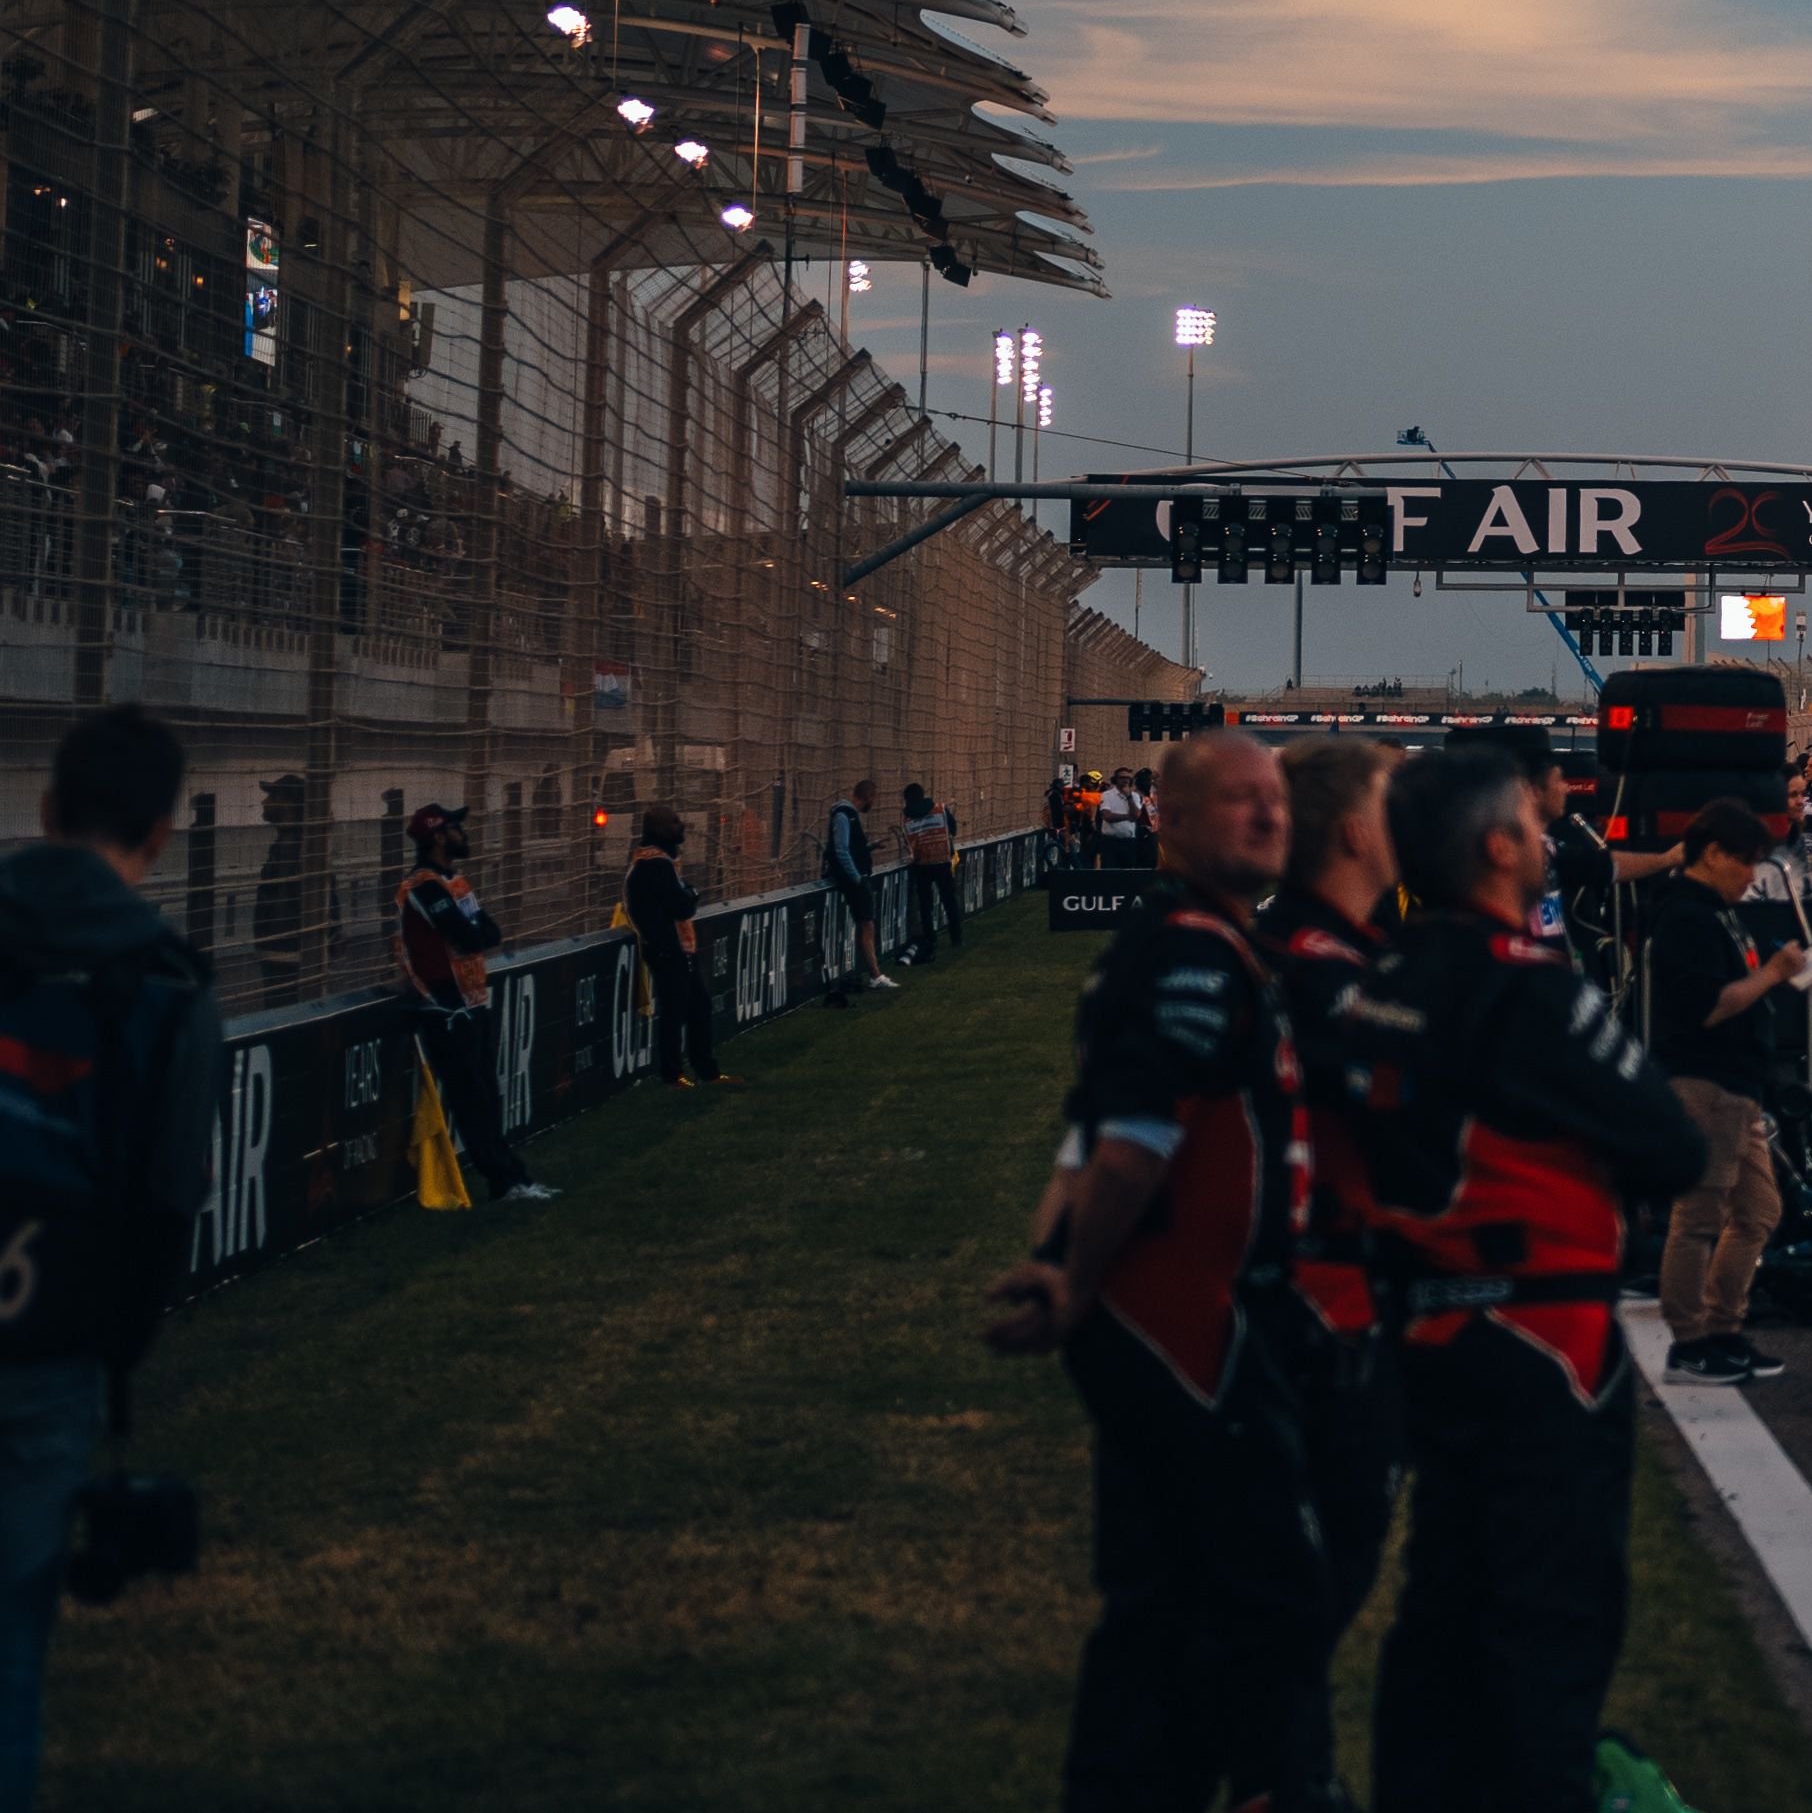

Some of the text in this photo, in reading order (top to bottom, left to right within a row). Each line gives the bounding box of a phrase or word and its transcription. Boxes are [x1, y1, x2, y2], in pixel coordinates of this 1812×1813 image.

[1467, 485, 1643, 554] AIR
[1063, 895, 1125, 911] GULF
[190, 1044, 273, 1273] AIR
